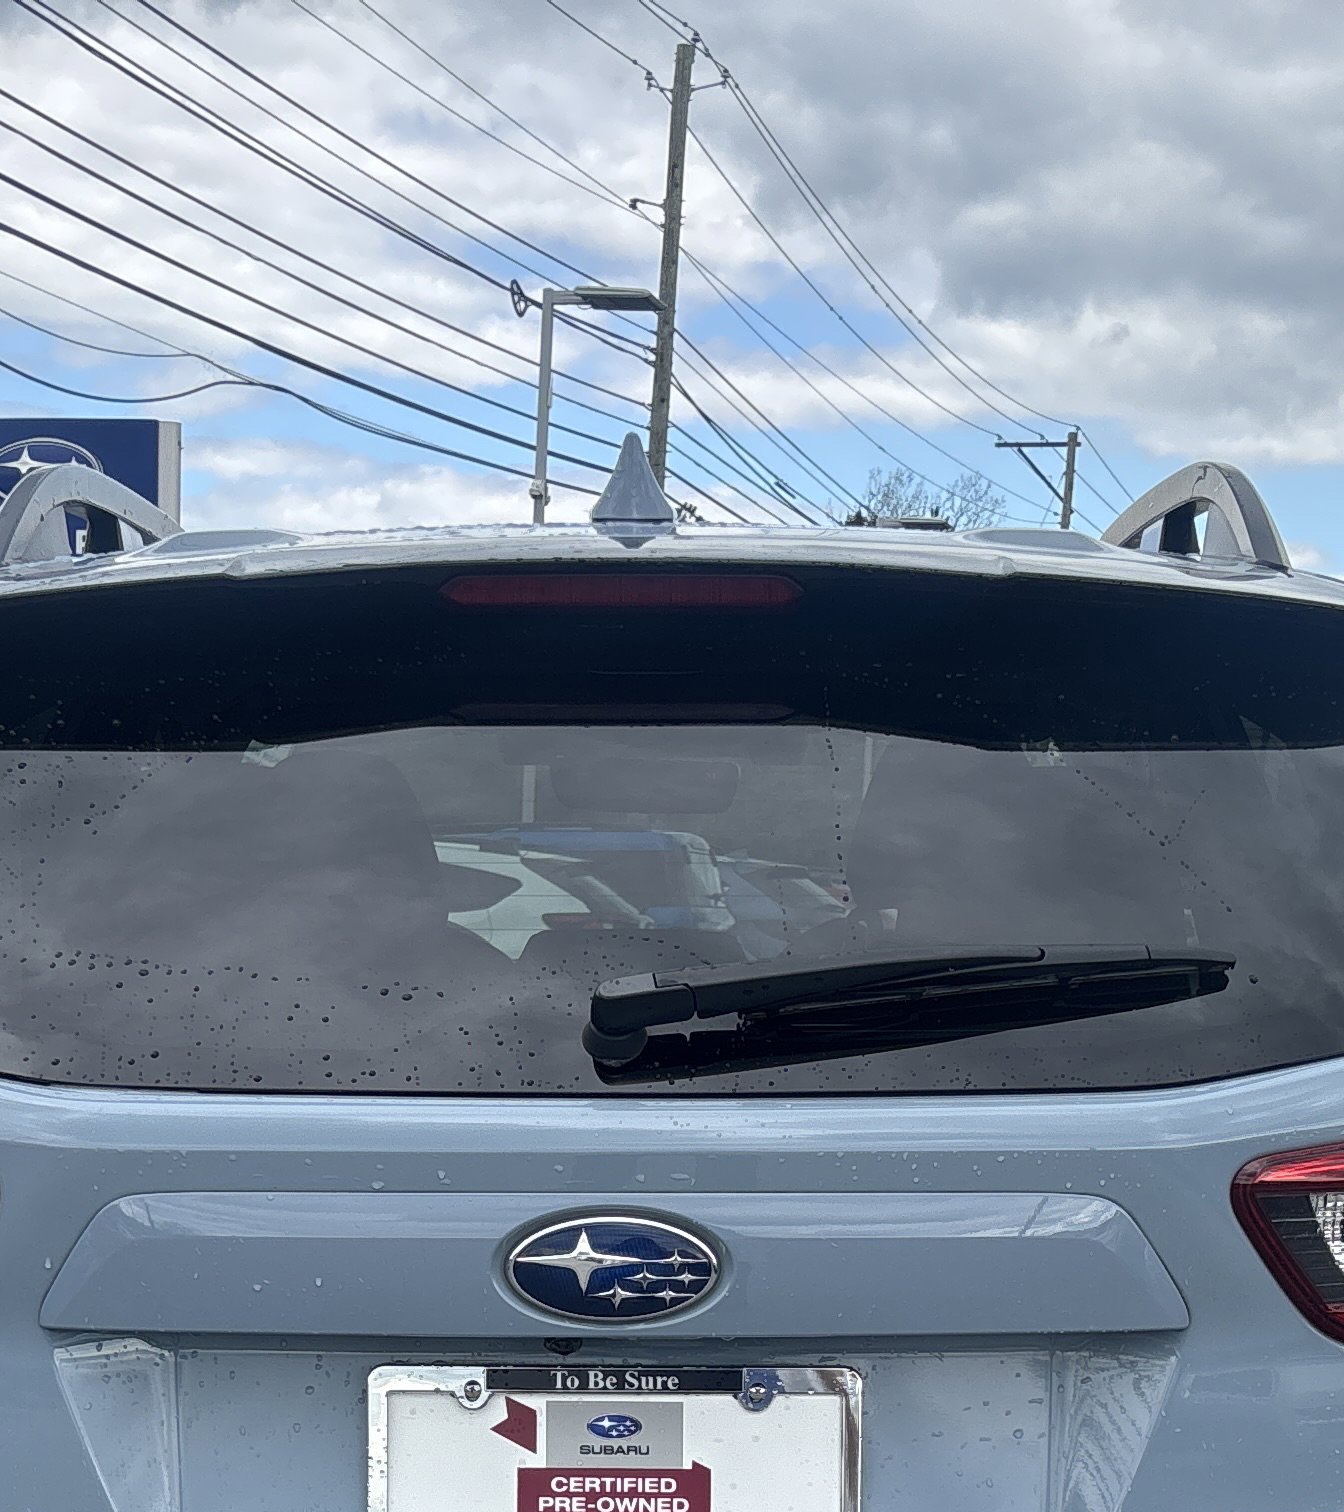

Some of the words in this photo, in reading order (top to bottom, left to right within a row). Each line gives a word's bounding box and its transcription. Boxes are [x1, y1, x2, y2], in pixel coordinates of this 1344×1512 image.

[551, 1370, 580, 1390] To
[587, 1370, 617, 1390] Be
[624, 1371, 680, 1391] Sure
[579, 1444, 650, 1456] SUBARU
[550, 1476, 678, 1494] CERTIFIED
